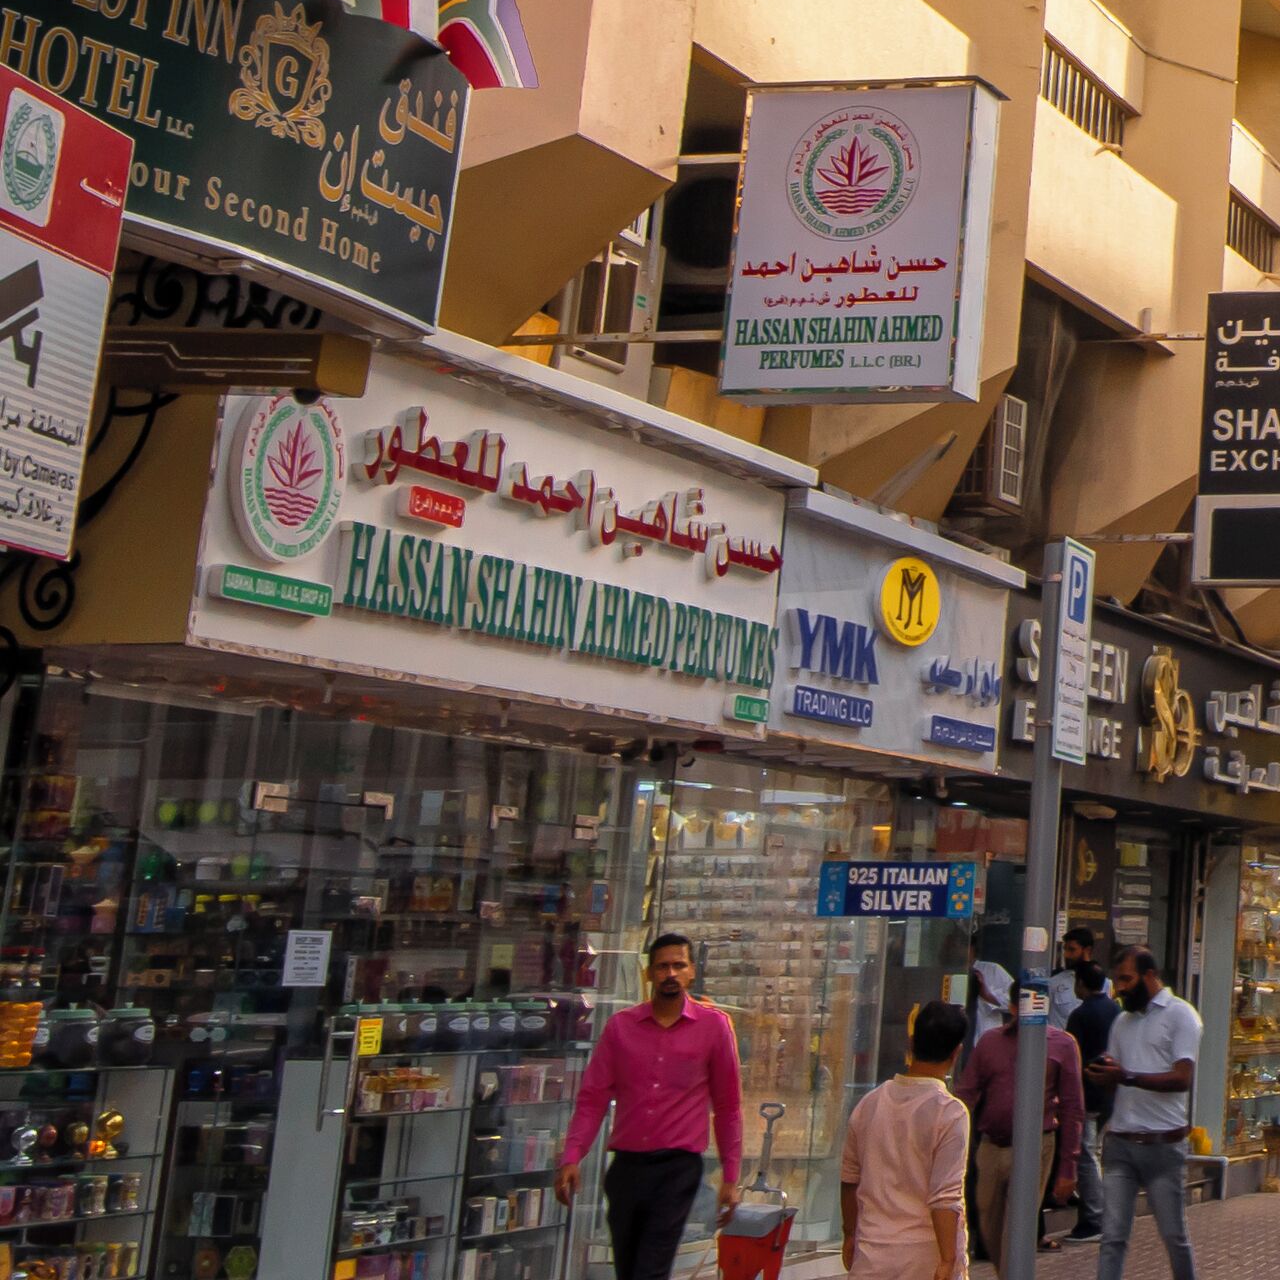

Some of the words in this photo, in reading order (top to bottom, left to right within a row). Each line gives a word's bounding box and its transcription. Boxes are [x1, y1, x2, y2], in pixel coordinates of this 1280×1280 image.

[1, 9, 161, 128] HOTEL
[379, 79, 459, 153] فندق
[131, 161, 190, 200] our
[205, 176, 309, 241] Second
[319, 219, 381, 275] Home
[800, 245, 881, 282] شاهين
[887, 254, 948, 281] حسن
[835, 286, 919, 308] للعطور
[735, 317, 807, 346] HASSAN
[806, 316, 878, 345] SHAHIN
[878, 314, 944, 344] AHMED
[759, 349, 844, 370] PERFUMES
[4, 450, 19, 479] by
[22, 455, 74, 491] Cameras
[365, 406, 506, 494] للعطور
[601, 487, 708, 558] شاهين
[712, 522, 783, 578] حسن
[343, 521, 473, 628] HASSAN
[472, 554, 581, 650] SHAHIN
[578, 580, 669, 668] AHMED
[669, 602, 778, 690] PERFUMES
[797, 608, 879, 685] YMK
[798, 689, 847, 719] TRADING
[850, 701, 873, 724] LLC
[849, 867, 878, 885] 925
[882, 867, 949, 886] ITALIAN
[860, 890, 932, 911] SILVER
